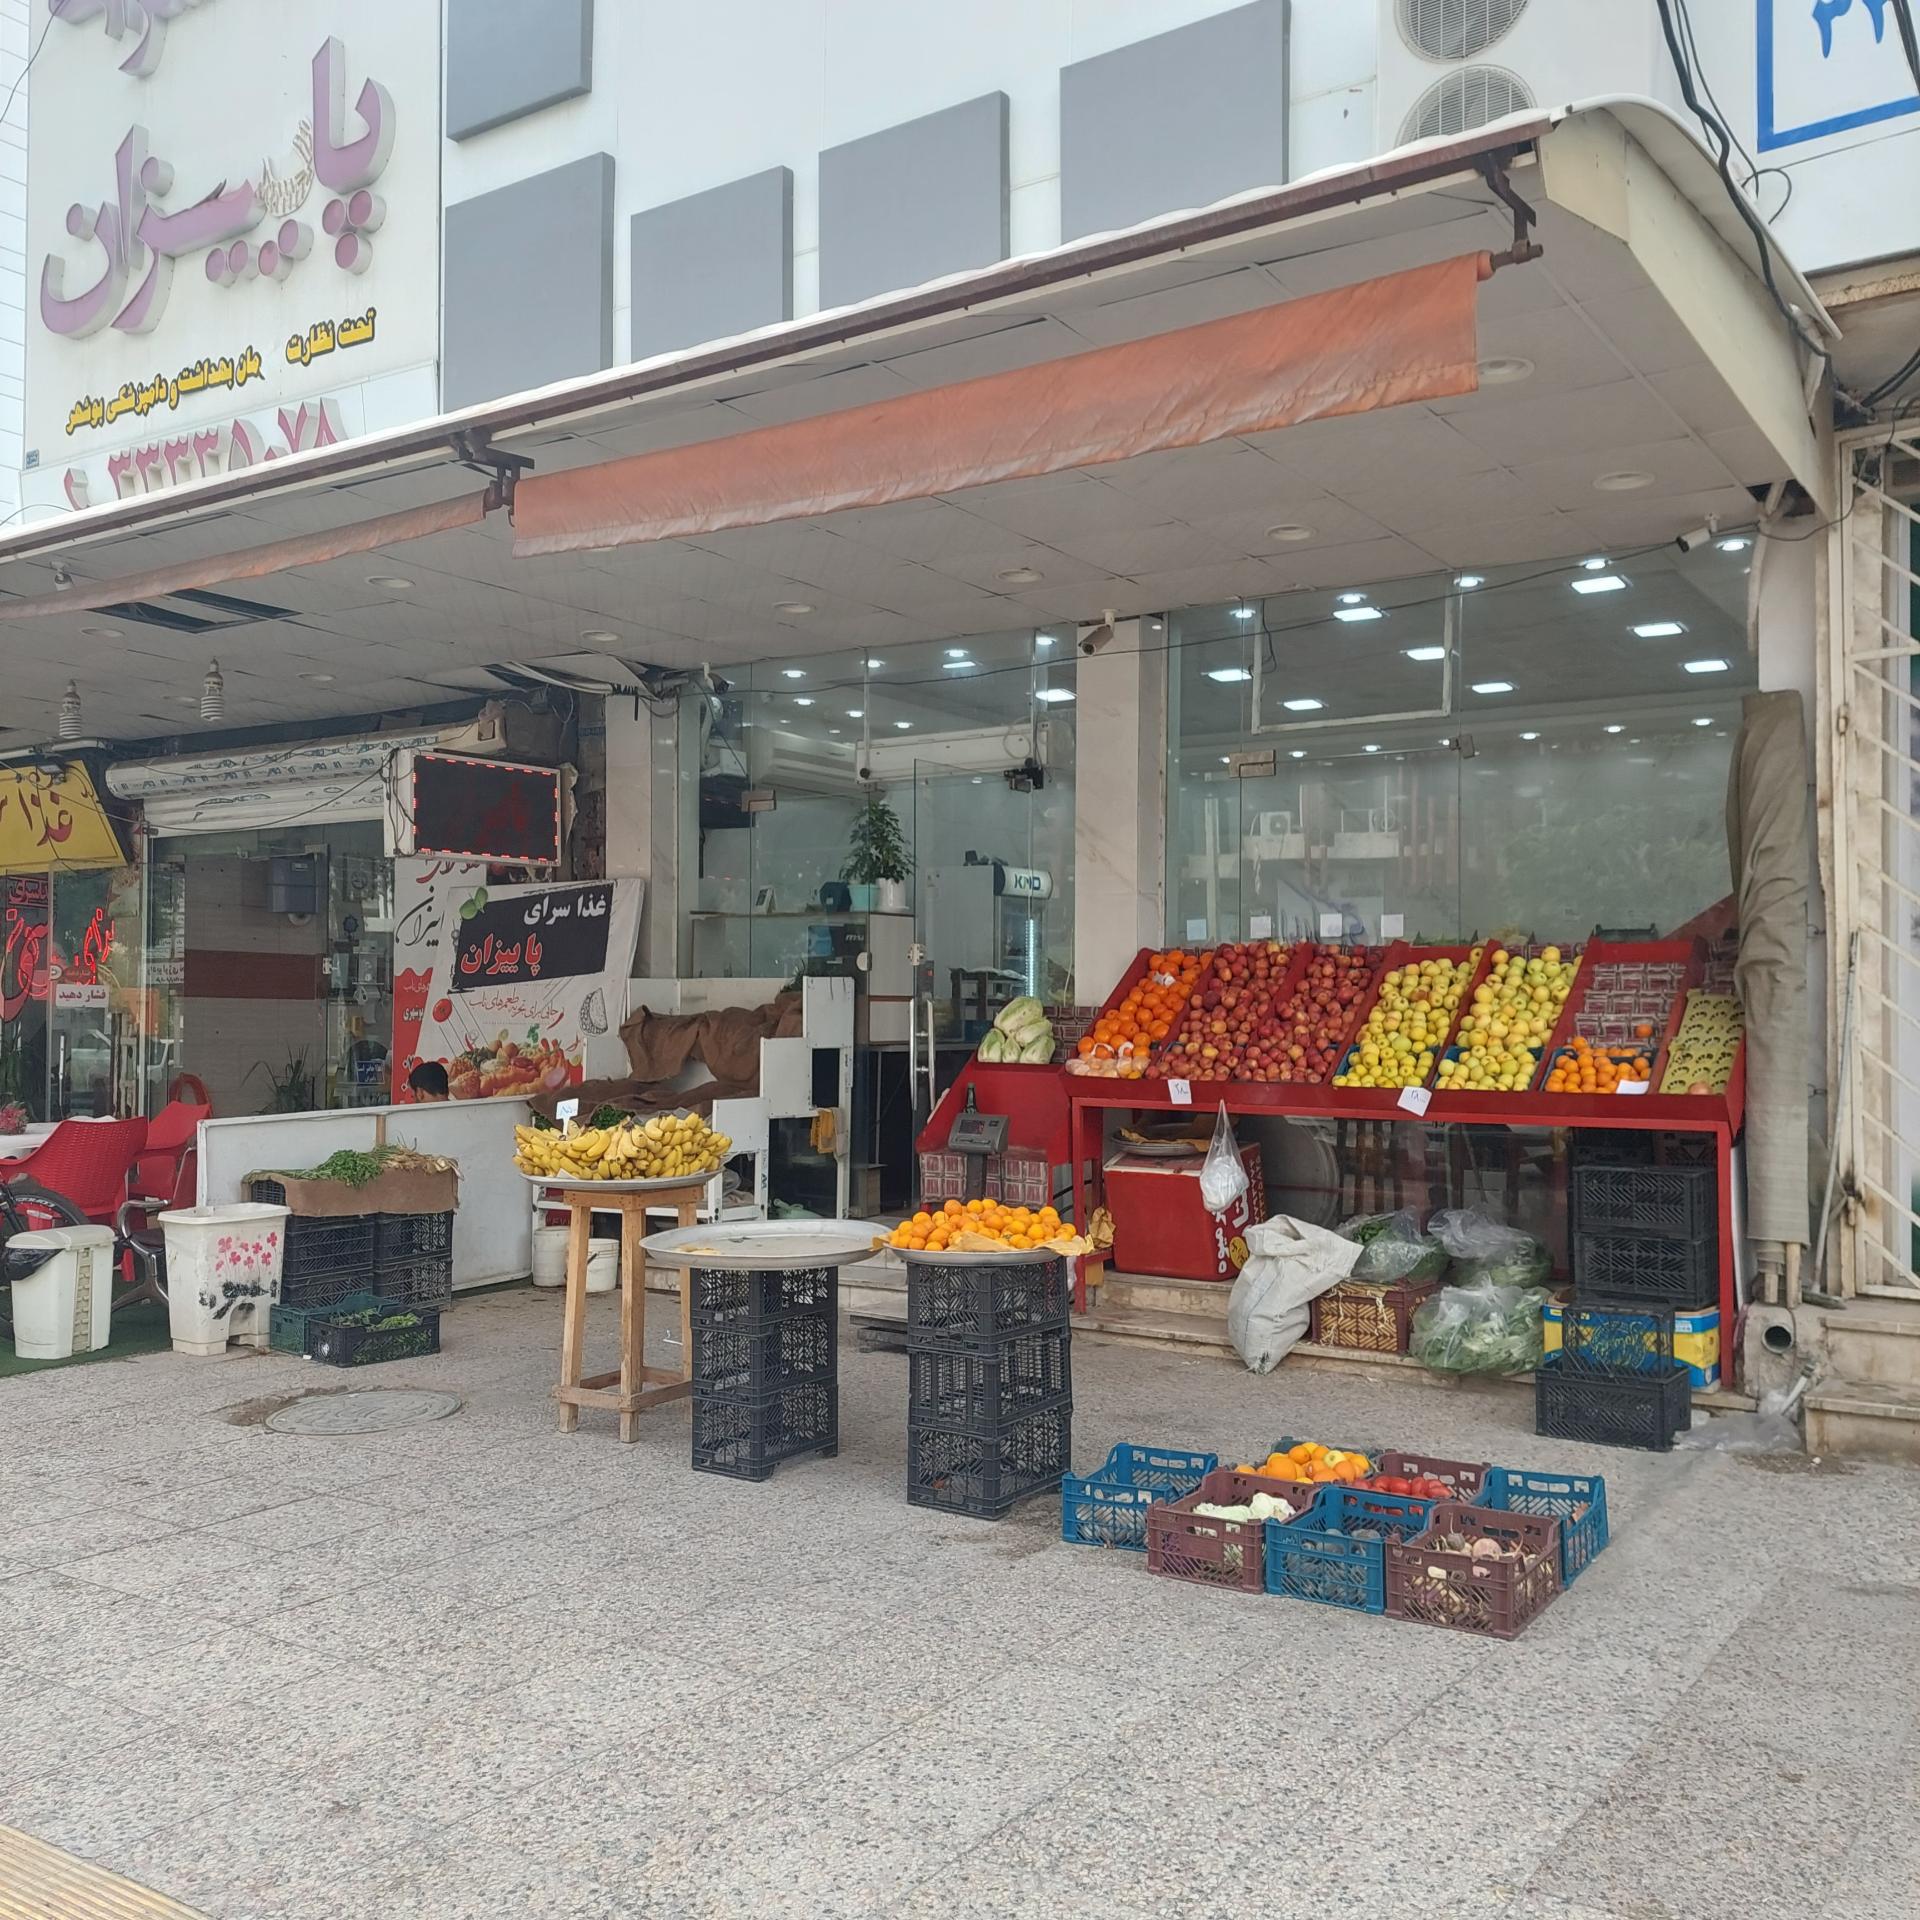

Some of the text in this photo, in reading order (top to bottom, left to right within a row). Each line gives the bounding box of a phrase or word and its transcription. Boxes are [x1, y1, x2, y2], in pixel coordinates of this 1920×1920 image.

[286, 319, 336, 367] نظارت
[337, 307, 377, 348] تحت
[523, 892, 608, 926] غذا سرای
[58, 988, 106, 1002] فشار دهید
